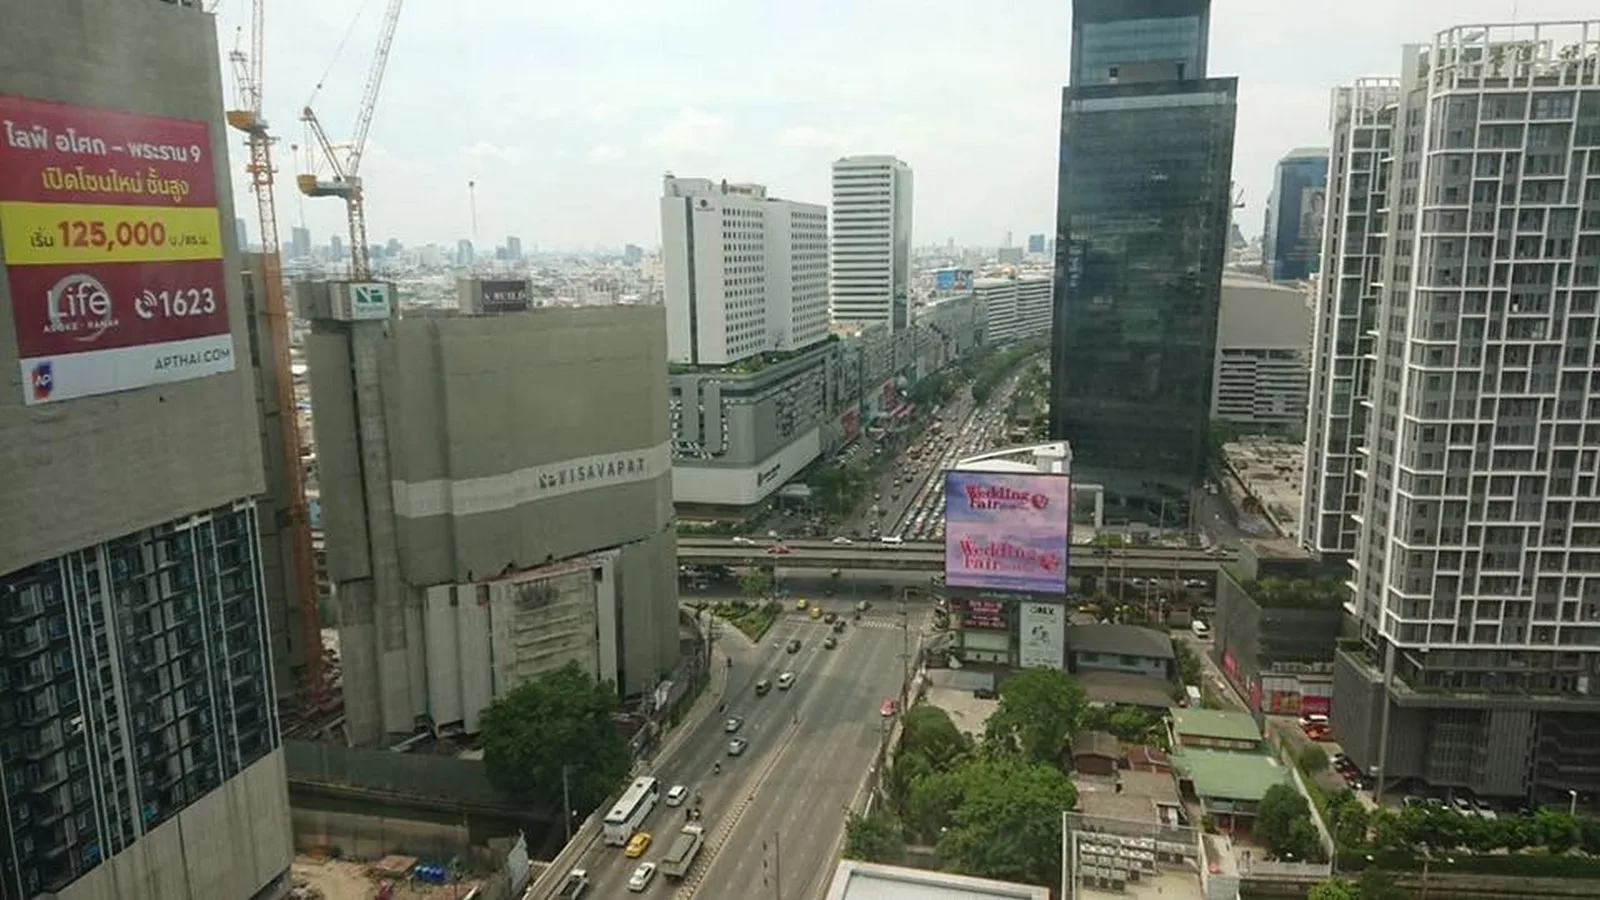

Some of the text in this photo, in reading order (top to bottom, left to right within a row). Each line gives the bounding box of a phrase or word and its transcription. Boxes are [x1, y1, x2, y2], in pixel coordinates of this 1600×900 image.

[55, 127, 107, 156] อโศก
[127, 142, 188, 162] พระราม
[190, 144, 202, 163] 9
[58, 220, 166, 252] 125,000
[47, 281, 110, 317] Life
[158, 288, 216, 317] 1623
[154, 348, 230, 370] APTHAI.COM
[965, 485, 1029, 504] Wedding
[960, 538, 1036, 562] Wedding
